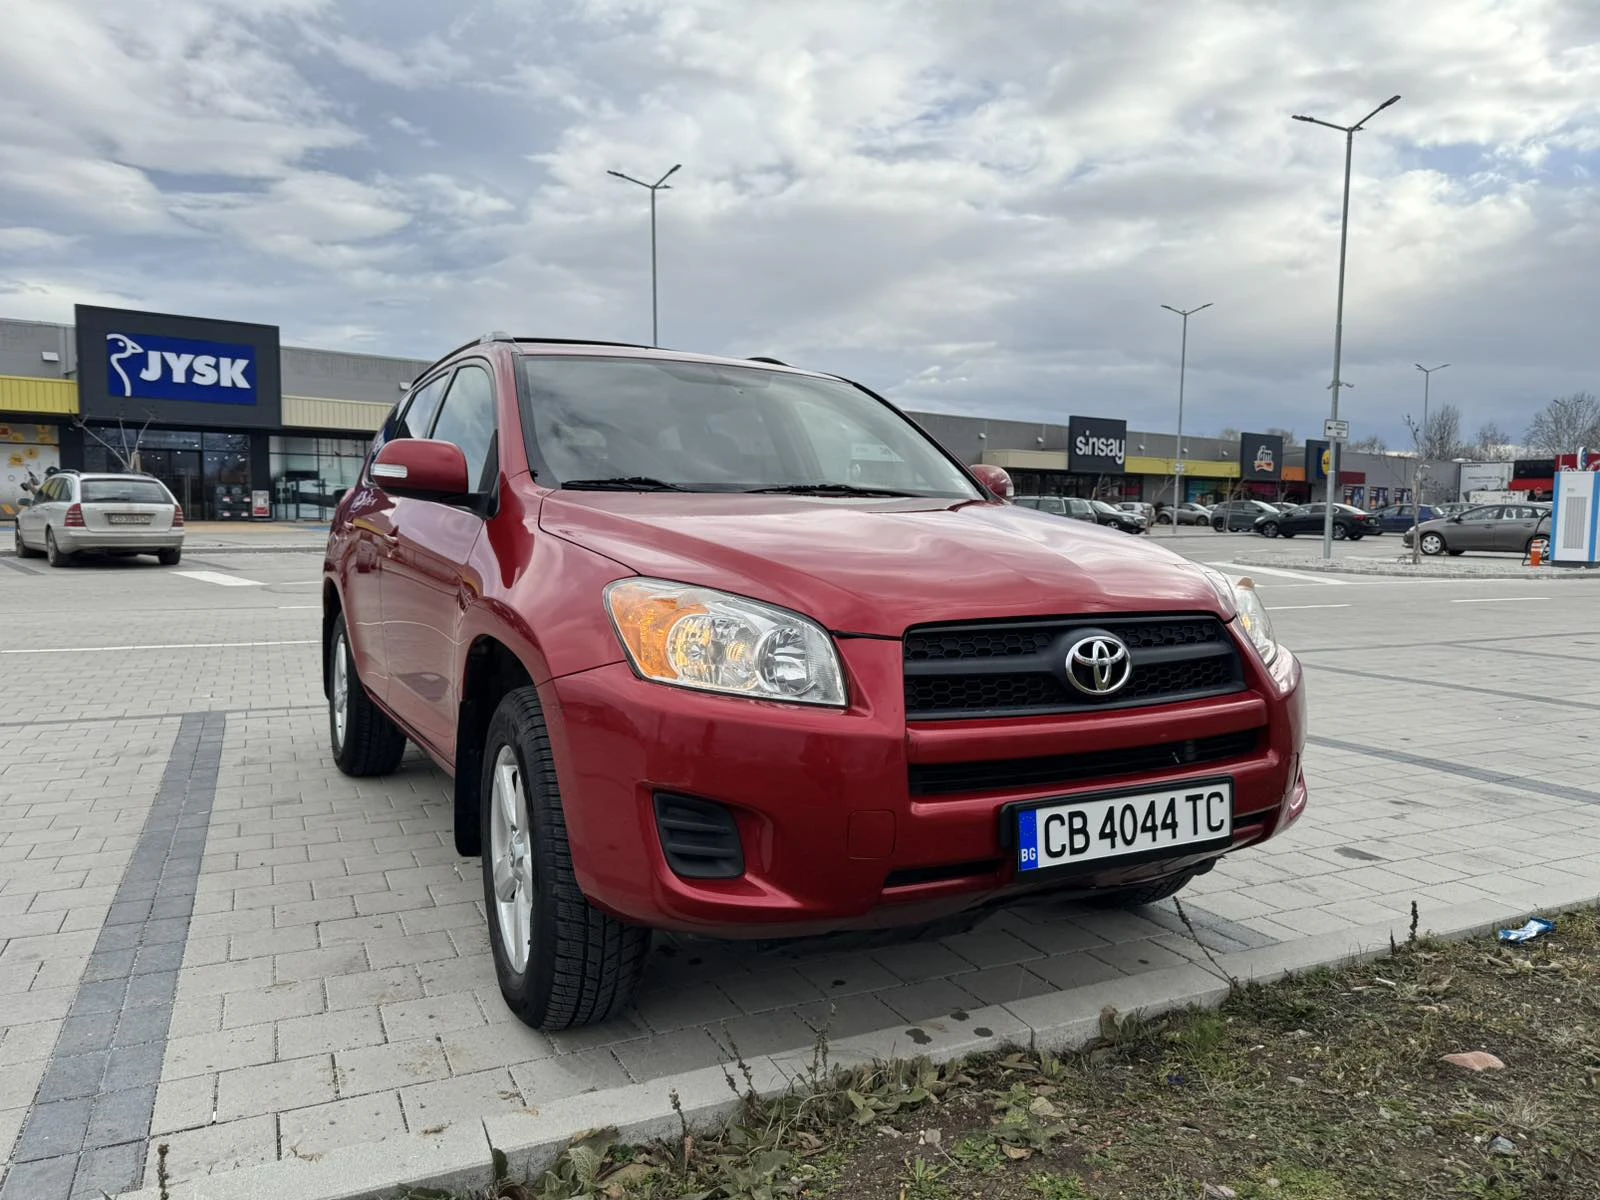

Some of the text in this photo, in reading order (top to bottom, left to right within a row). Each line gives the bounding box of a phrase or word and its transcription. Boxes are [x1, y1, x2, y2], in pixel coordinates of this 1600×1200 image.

[139, 350, 251, 389] JYSK
[1075, 430, 1125, 464] sinsay
[1044, 791, 1225, 858] CB 4044 TC
[1021, 847, 1037, 863] BG
